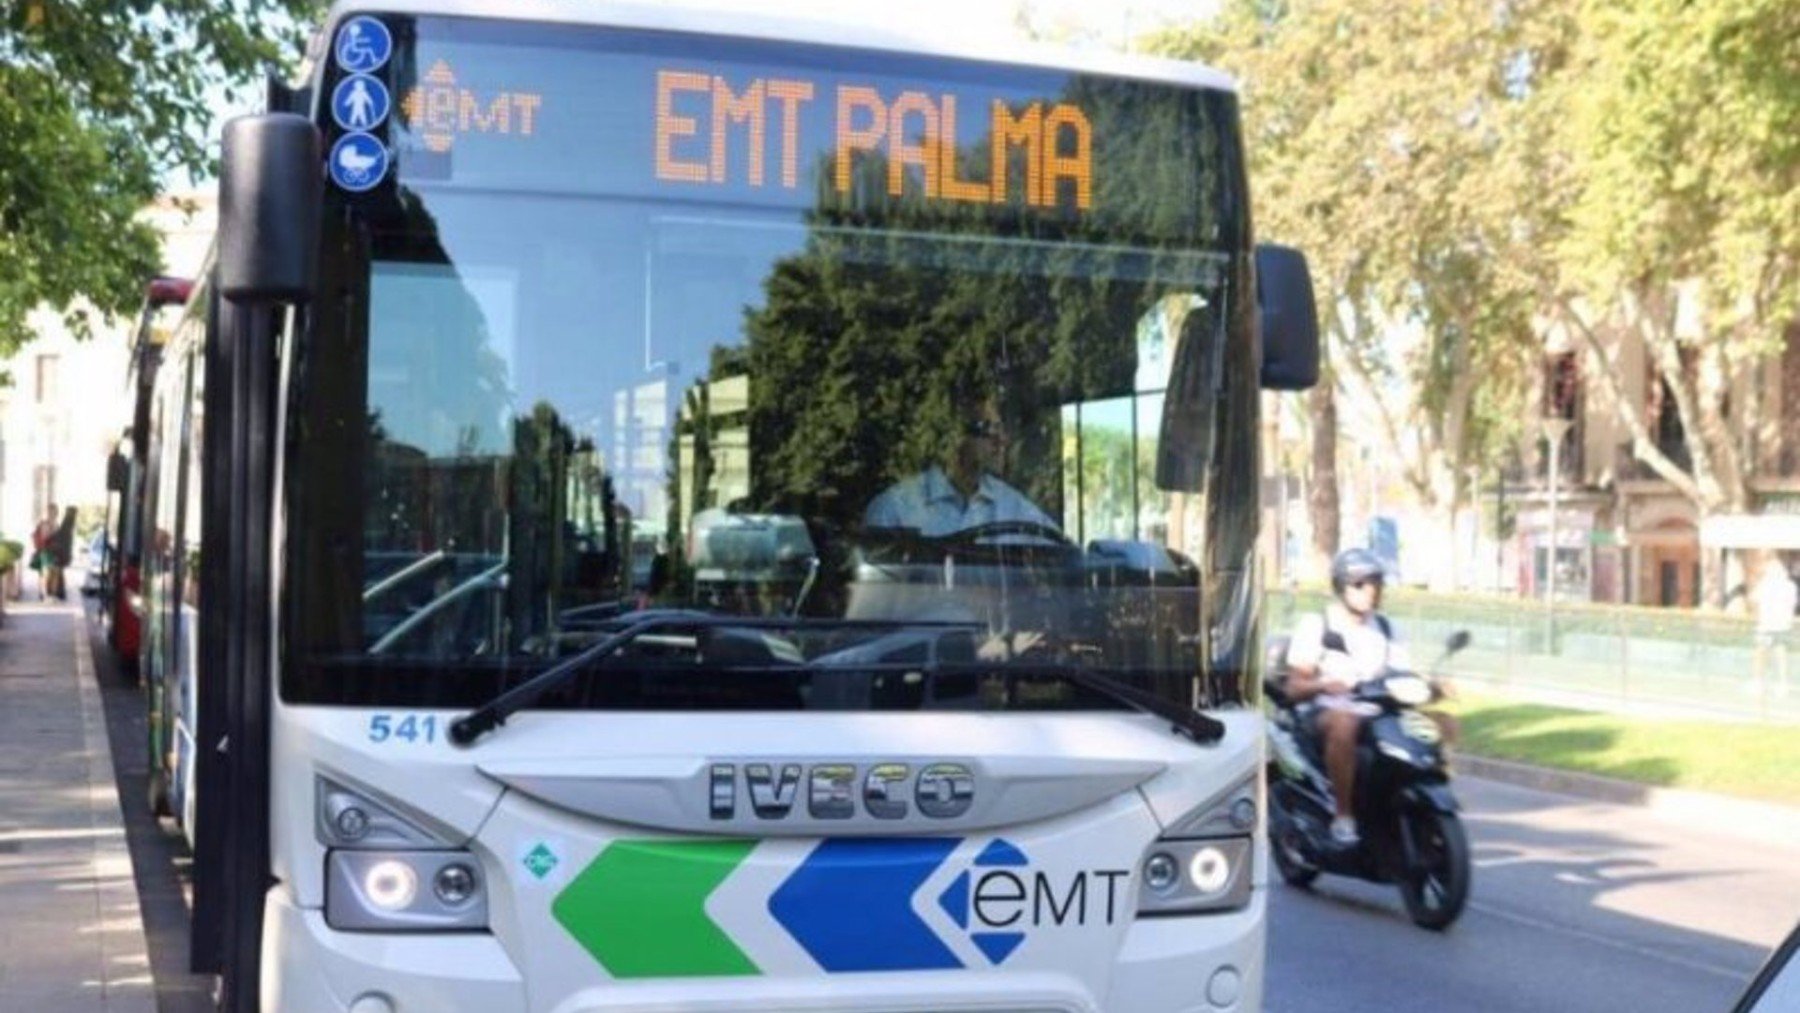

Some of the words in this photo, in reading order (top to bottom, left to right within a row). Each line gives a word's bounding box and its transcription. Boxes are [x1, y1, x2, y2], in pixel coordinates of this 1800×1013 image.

[655, 70, 814, 188] EMT
[834, 84, 1092, 209] PALMA
[369, 715, 436, 743] 541
[709, 763, 975, 820] IVECO
